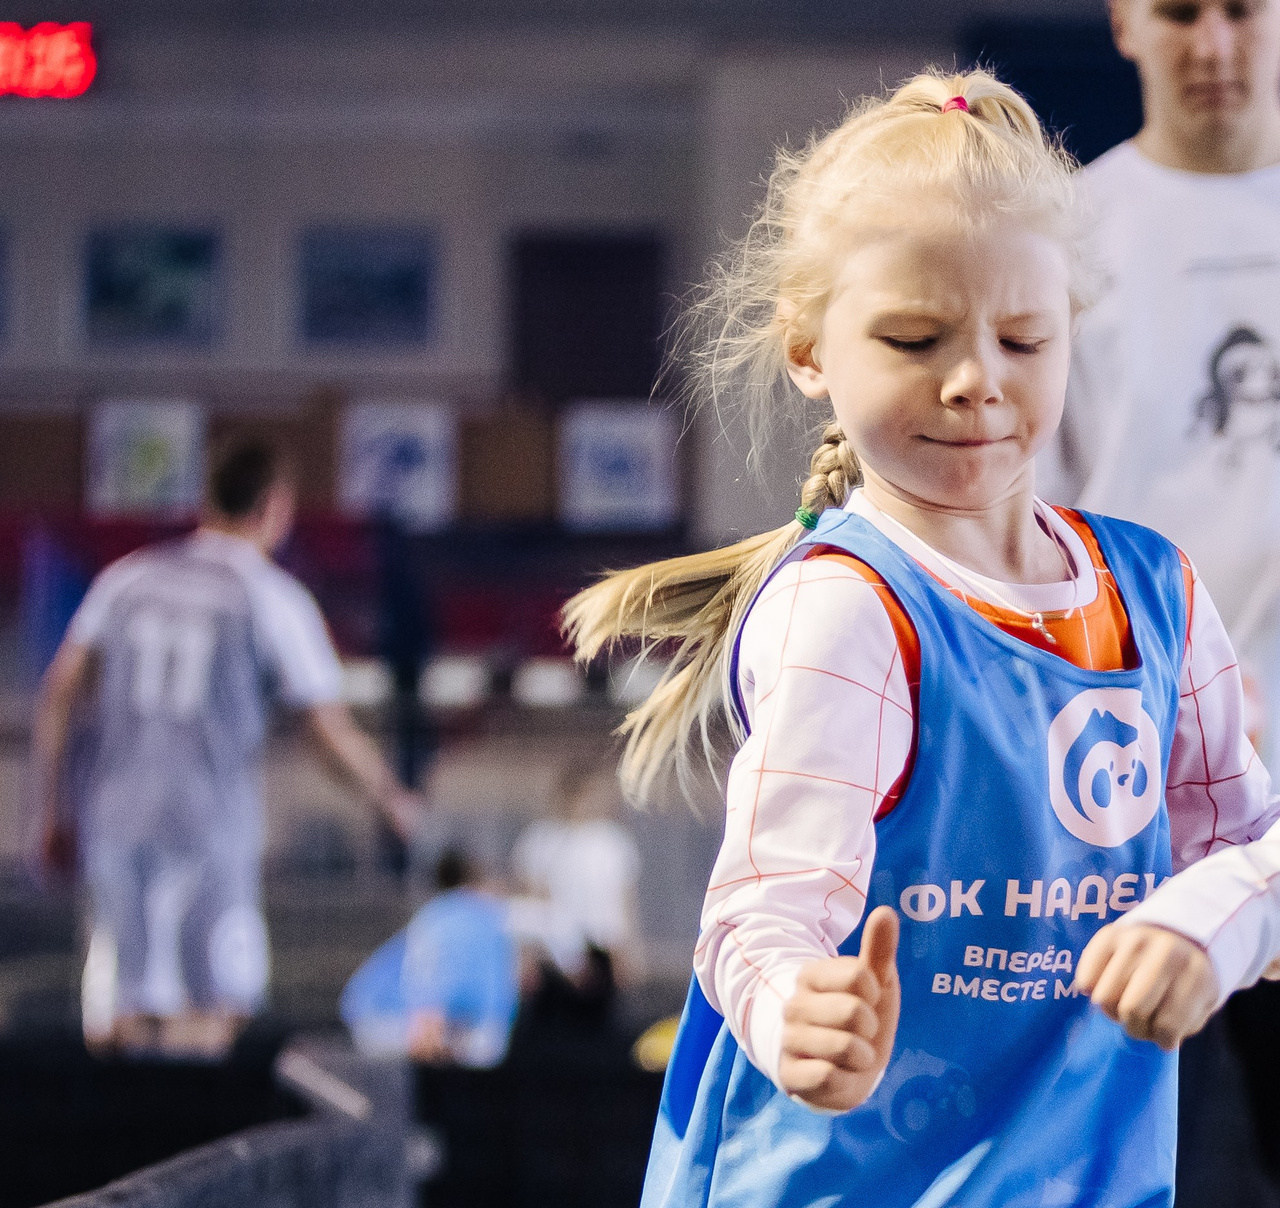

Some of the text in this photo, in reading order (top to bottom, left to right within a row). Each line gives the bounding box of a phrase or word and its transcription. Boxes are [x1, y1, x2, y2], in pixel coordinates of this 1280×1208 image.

[899, 878, 987, 923] ФК
[963, 944, 1073, 974] ВПЕРЁД
[931, 972, 1048, 1003] ВМЕСТЕ
